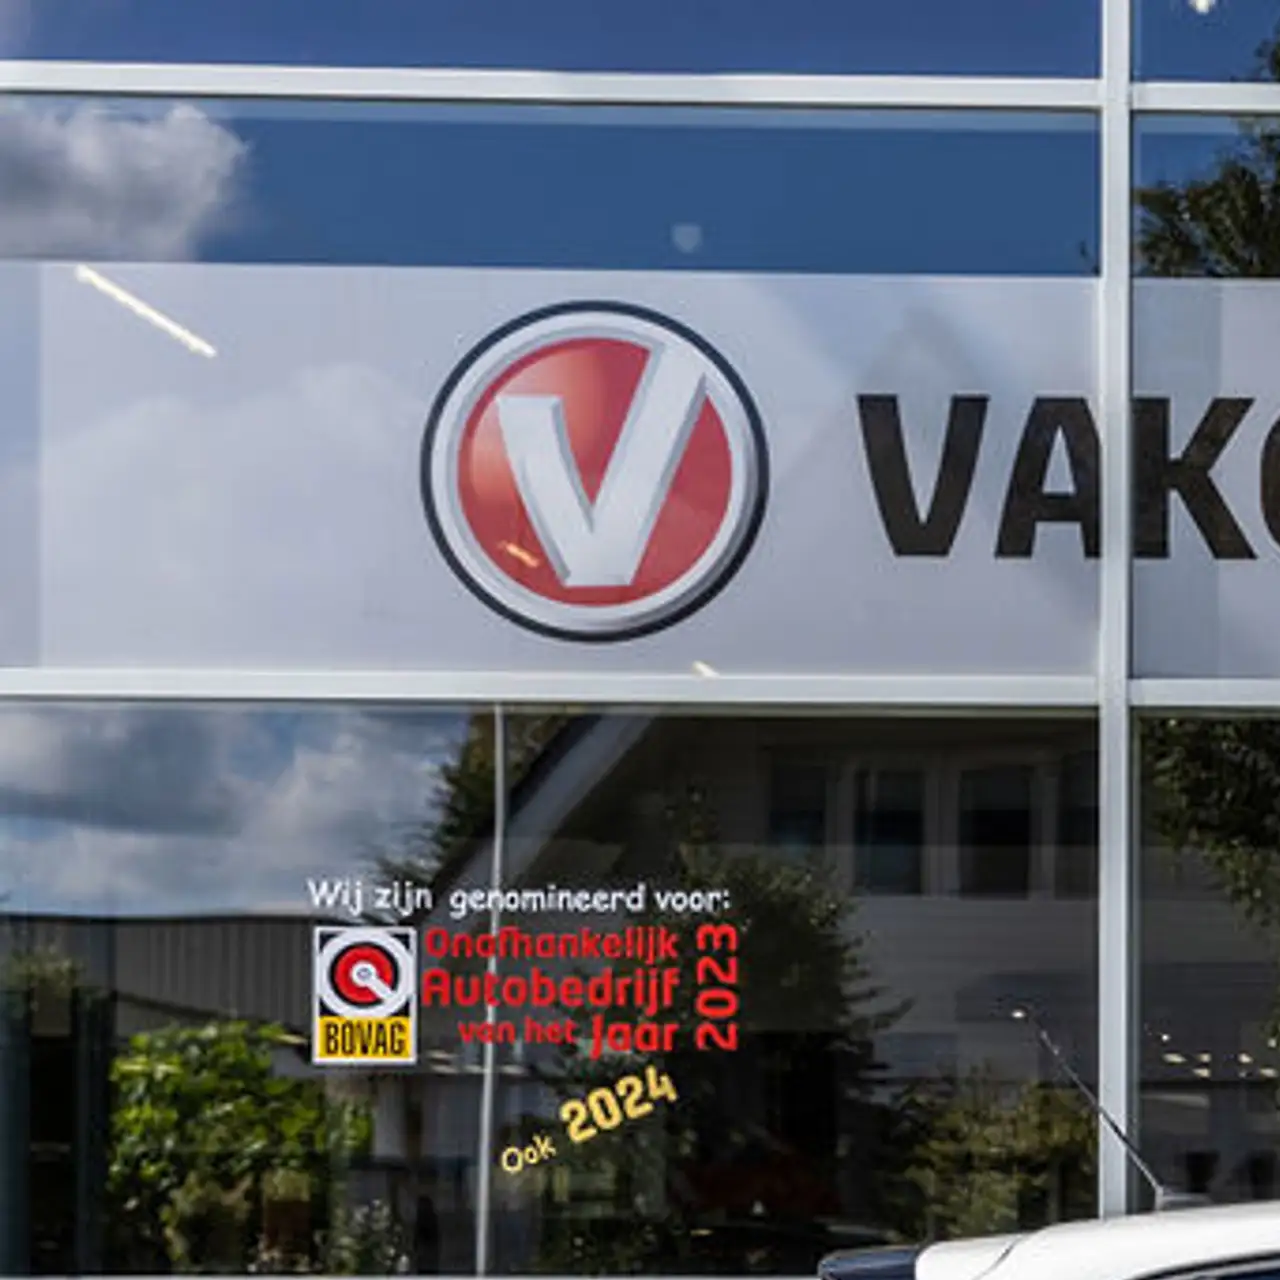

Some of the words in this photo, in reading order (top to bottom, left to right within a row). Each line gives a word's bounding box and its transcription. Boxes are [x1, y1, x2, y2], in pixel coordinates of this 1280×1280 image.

[307, 880, 363, 917] Wij
[374, 880, 432, 917] zijn
[449, 882, 646, 919] genomineerd
[655, 888, 730, 912] voor:
[424, 925, 679, 965] Onafhankelijk
[421, 966, 681, 1017] Autobedrijf
[695, 922, 739, 1052] 2023
[324, 1019, 407, 1056] BOVAG
[458, 1021, 515, 1044] van
[523, 1015, 579, 1044] het
[501, 1130, 557, 1174] Ook
[559, 1064, 678, 1144] 2024
